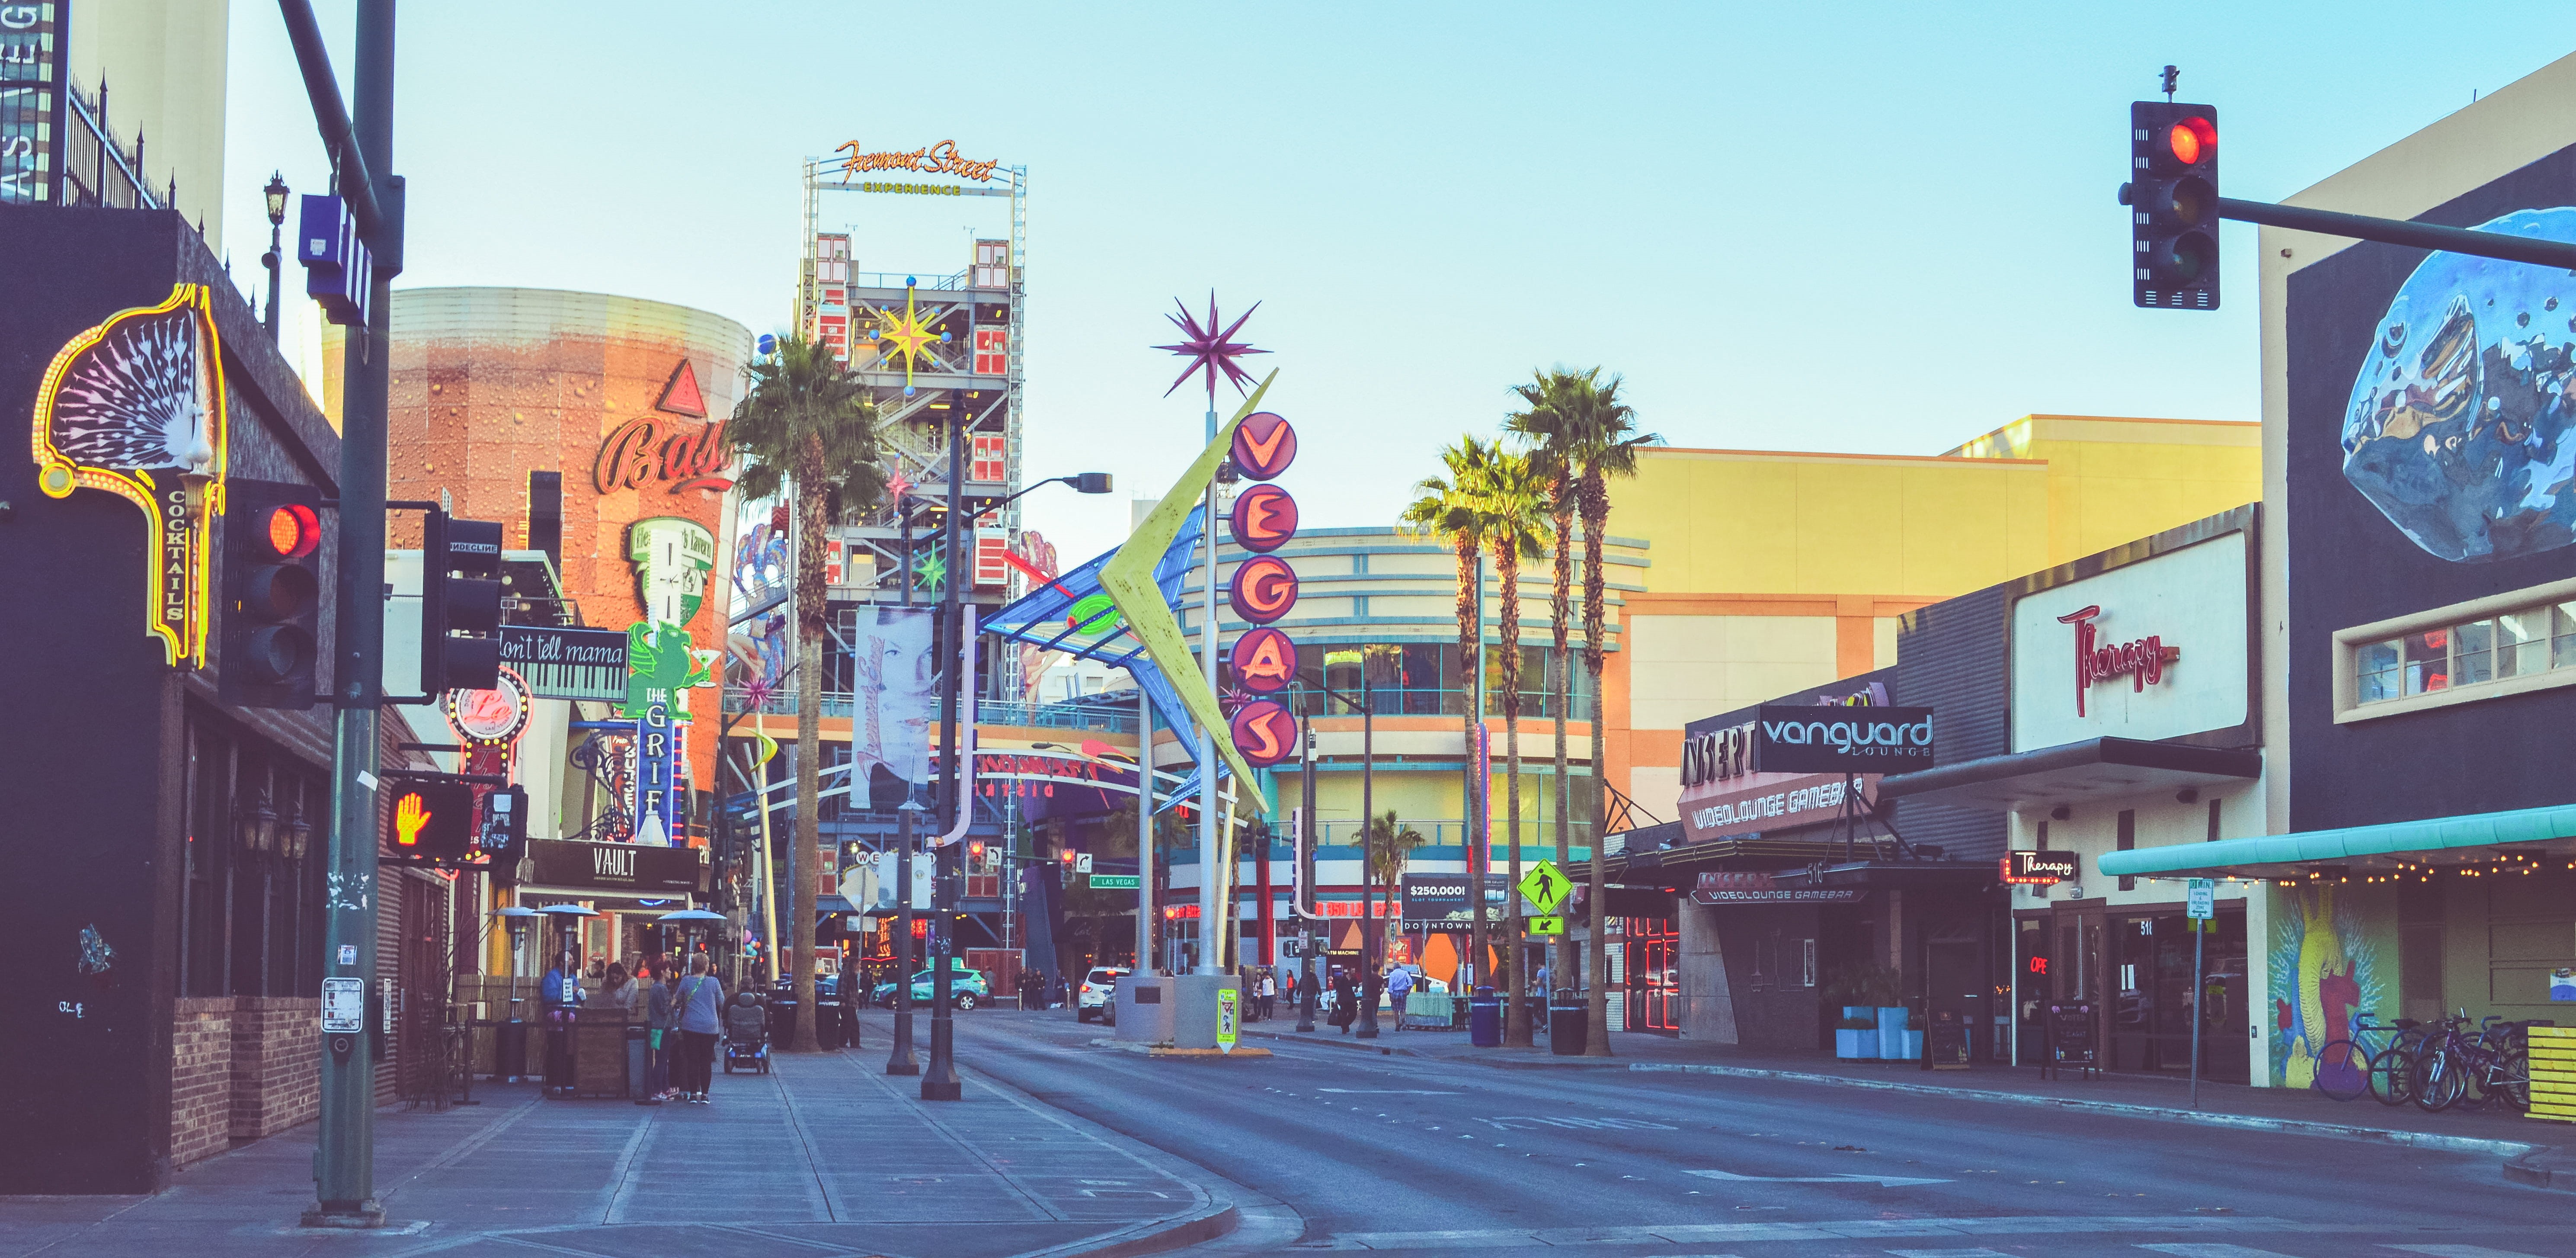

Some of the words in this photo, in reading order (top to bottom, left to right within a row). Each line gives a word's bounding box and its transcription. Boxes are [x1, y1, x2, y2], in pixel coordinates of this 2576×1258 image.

[835, 139, 926, 186] Fremont
[924, 139, 998, 183] Street
[863, 182, 961, 196] EXPERIENCE
[167, 490, 186, 621] COCKTAILS
[691, 529, 712, 559] Tavern
[1240, 420, 1296, 758] VEGAS
[537, 634, 562, 661] tell
[566, 644, 624, 664] mama
[2057, 605, 2166, 718] Therapy
[646, 688, 667, 703] THE
[1763, 714, 1933, 754] vanguard
[645, 705, 666, 812] GRIF
[1680, 721, 1756, 787] INSERT
[1852, 747, 1930, 756] LOUNGE
[593, 847, 637, 876] VAULT
[2015, 852, 2073, 876] Therapy
[1410, 885, 1466, 897] $250,000!
[1709, 891, 1791, 899] VIDEOLOUNGE
[1795, 890, 1853, 899] GAMEBAR
[1350, 902, 1365, 917] LB
[2030, 956, 2048, 975] OPE
